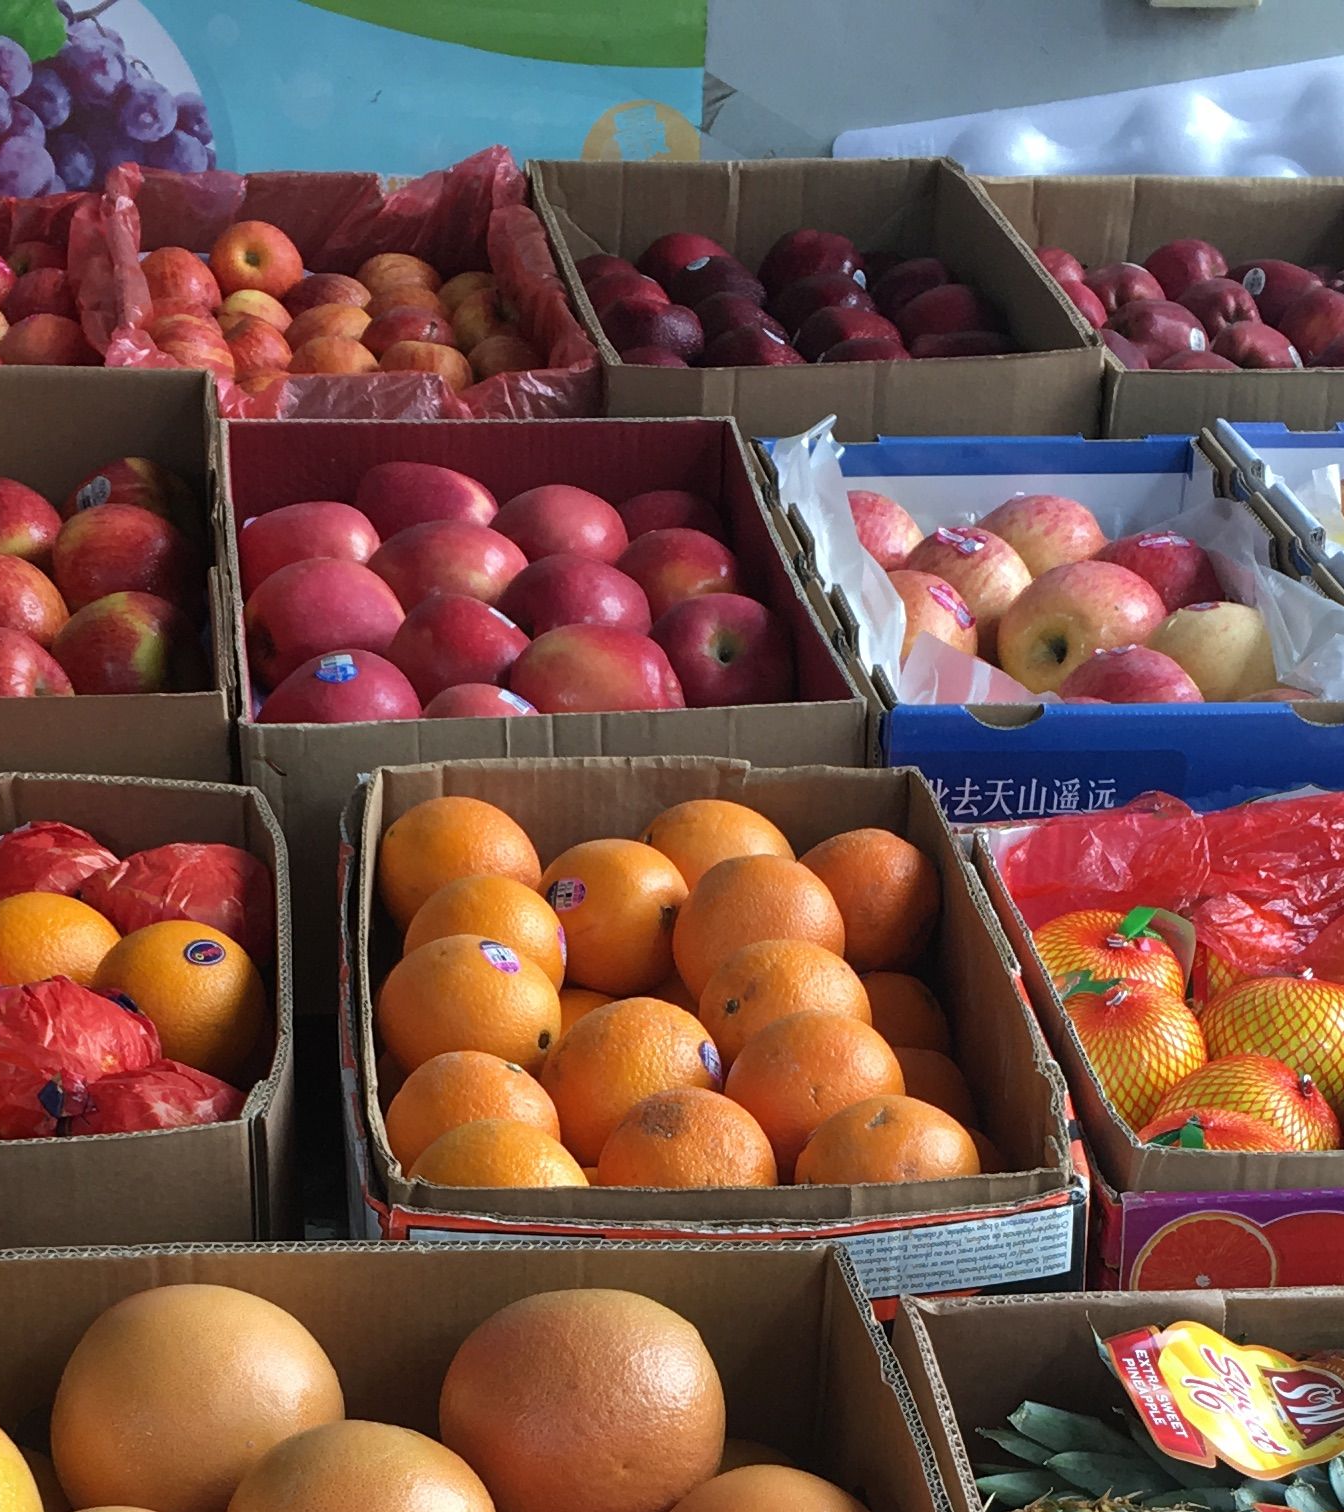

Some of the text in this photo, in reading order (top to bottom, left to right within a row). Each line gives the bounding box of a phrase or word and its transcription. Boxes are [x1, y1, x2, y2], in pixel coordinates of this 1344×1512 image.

[1121, 1356, 1168, 1427] PINEAPPLE
[1134, 1349, 1189, 1439] EXTRA SWEET
[1182, 1374, 1223, 1414] 16
[1200, 1344, 1291, 1456] Sweet
